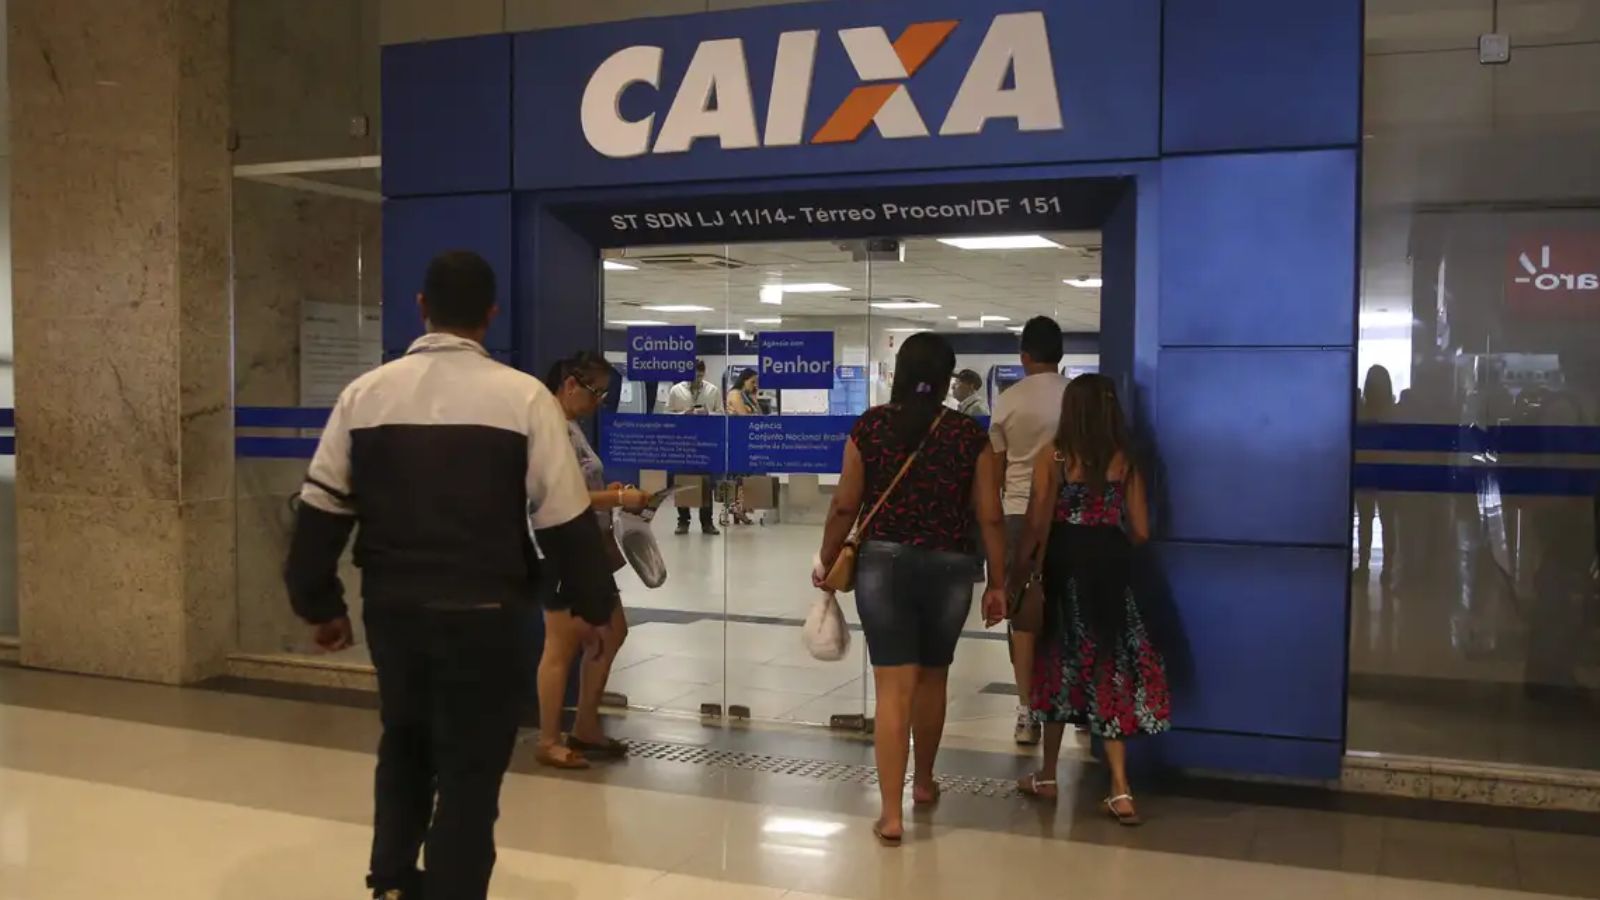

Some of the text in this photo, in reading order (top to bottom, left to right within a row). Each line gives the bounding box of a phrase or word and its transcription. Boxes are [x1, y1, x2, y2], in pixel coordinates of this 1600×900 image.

[581, 11, 1064, 157] CAIXA
[611, 214, 638, 230] ST
[644, 211, 693, 228] SDN
[697, 210, 724, 226] LJ
[800, 206, 876, 223] Térreo
[882, 198, 1010, 220] Procon/DF
[1020, 196, 1062, 215] 151
[632, 335, 694, 351] Câmbio
[632, 357, 694, 373] Exchange
[762, 355, 831, 374] Penhor
[749, 422, 782, 430] Agência
[749, 432, 784, 441] Conjunto
[785, 432, 822, 441] Nacional
